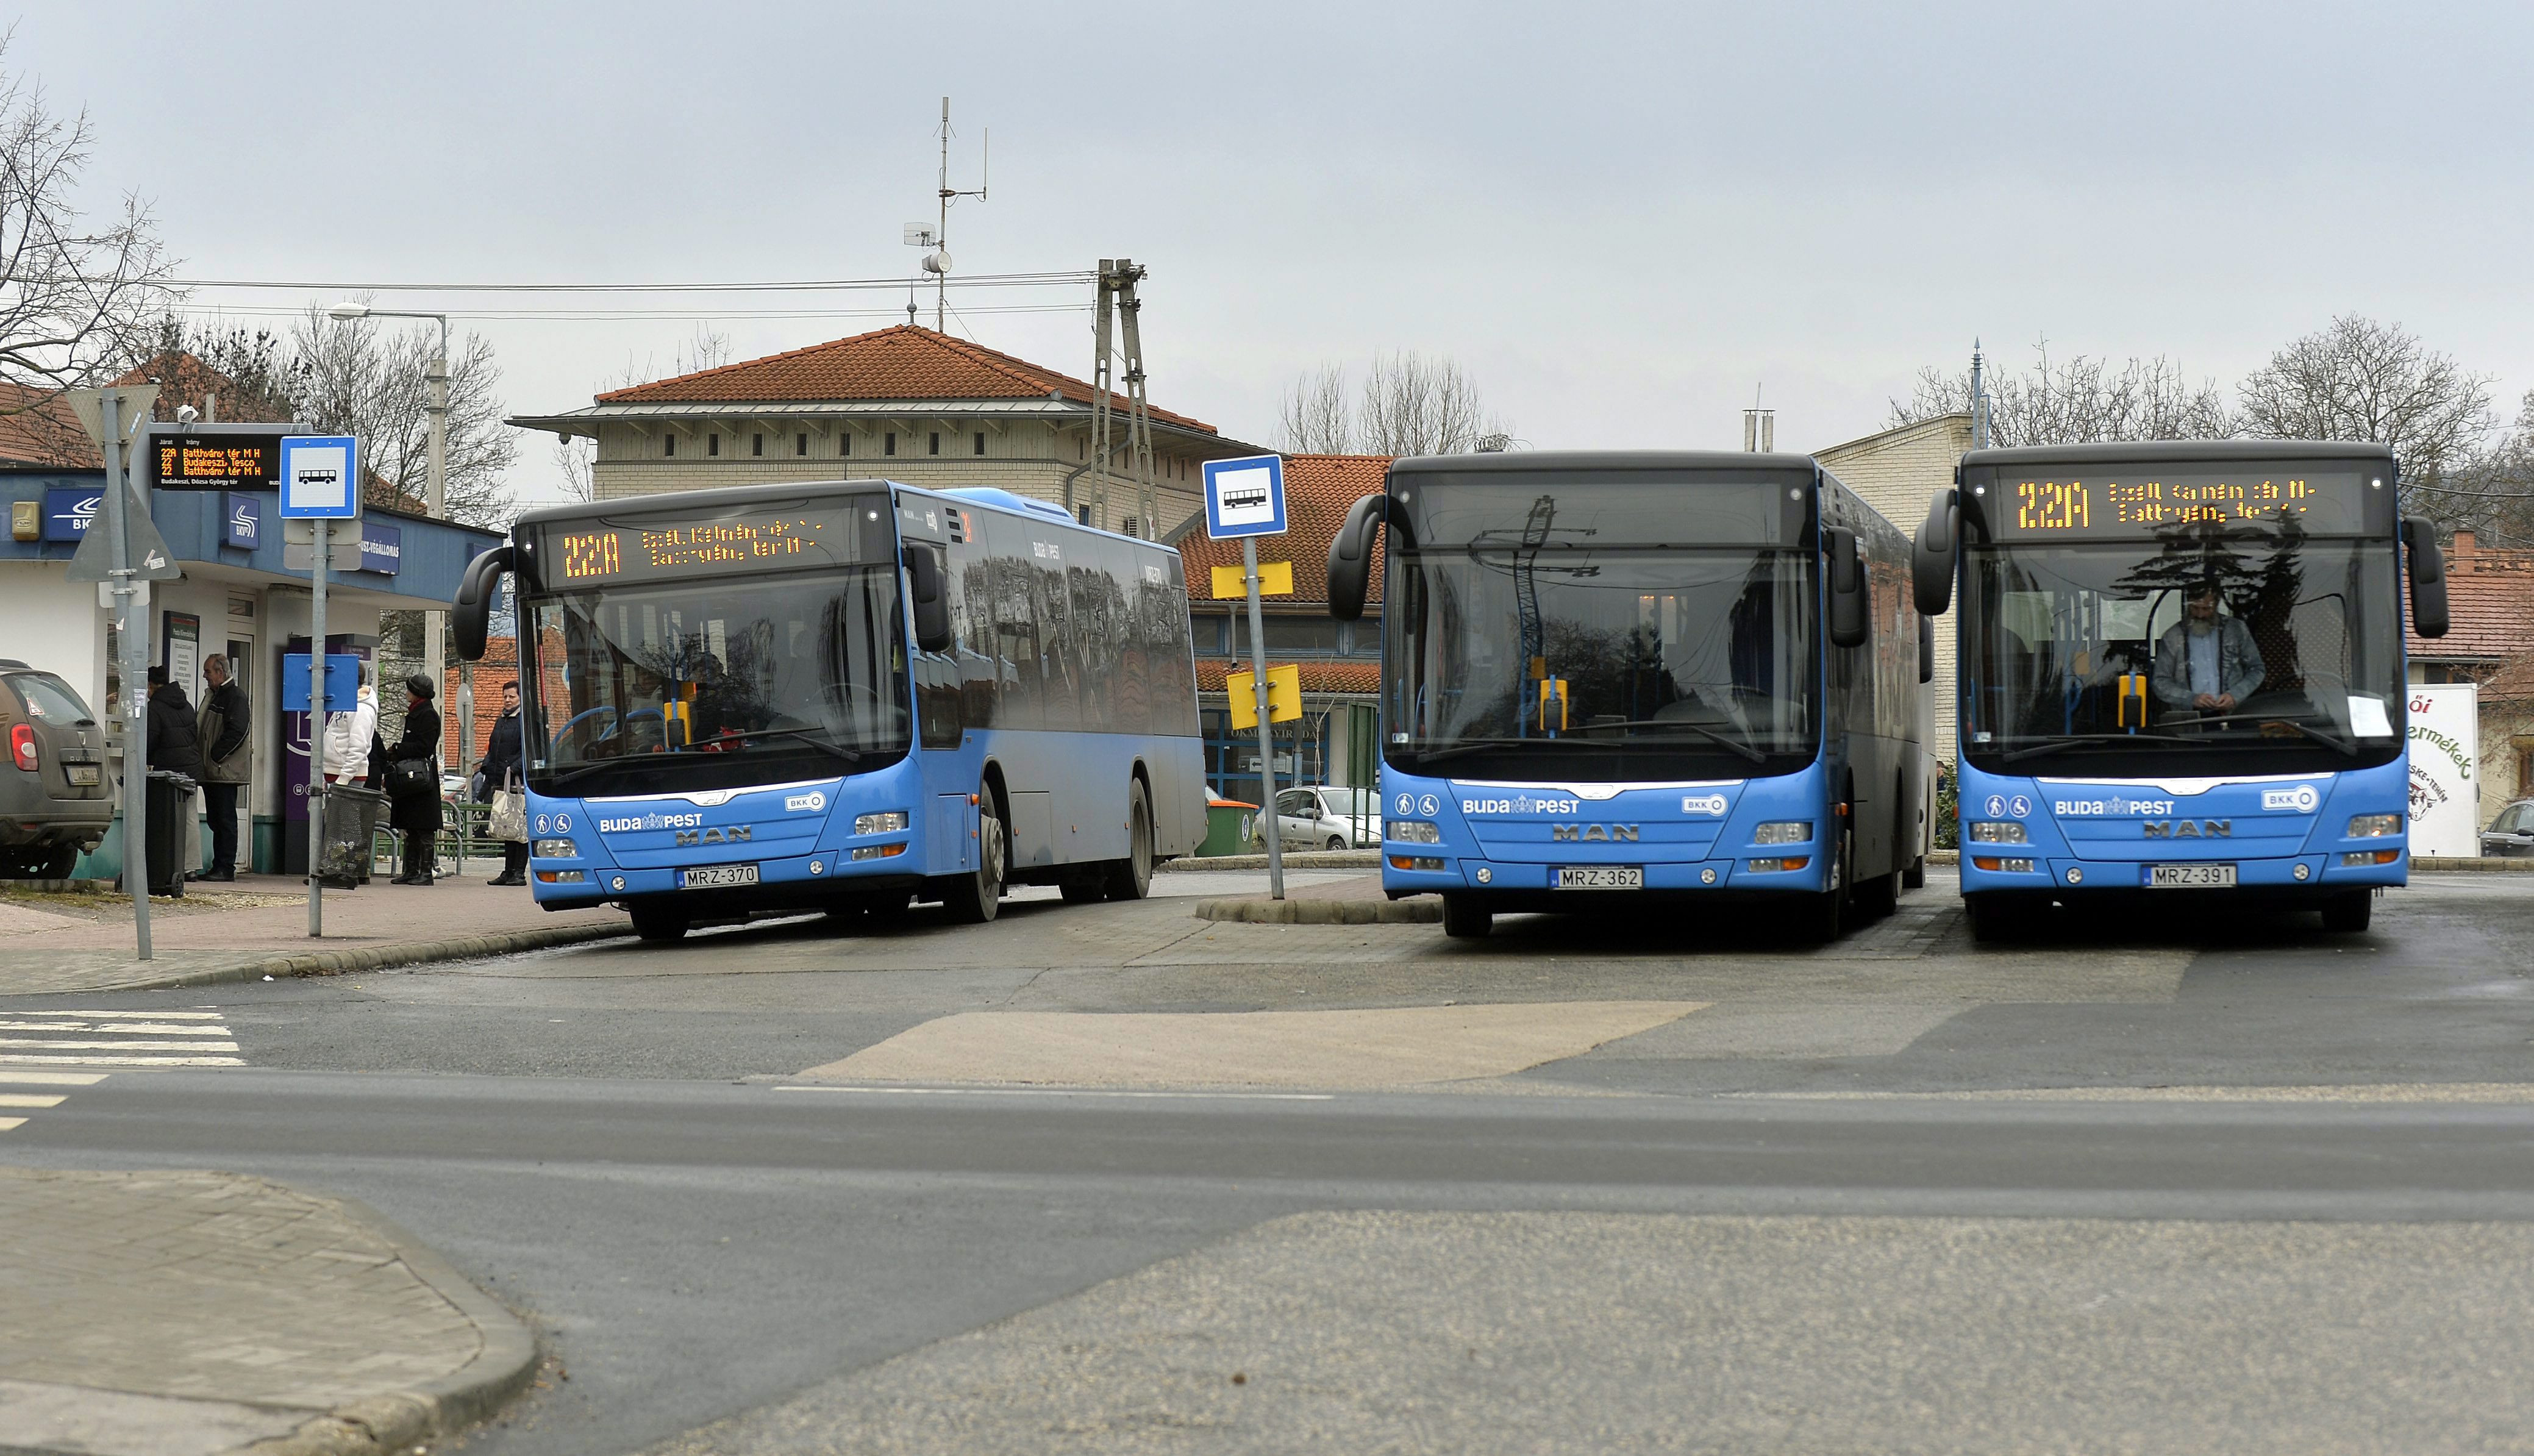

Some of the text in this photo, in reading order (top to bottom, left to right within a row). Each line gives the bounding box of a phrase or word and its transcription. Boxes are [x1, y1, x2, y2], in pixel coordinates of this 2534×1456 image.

[161, 448, 261, 458] 22A Batthyány tér M H
[161, 457, 256, 467] 22 Budakeszi, Tesco
[162, 466, 262, 476] 22 Batthyány tér M H
[2018, 481, 2090, 529] 22A
[360, 539, 399, 558] USZ-VÉGÁLLOMÁS
[563, 533, 620, 577] 22A
[2408, 694, 2433, 713] ői
[2408, 726, 2472, 779] ermékek
[676, 826, 752, 846] MAN
[1553, 824, 1639, 841] MAN
[2143, 819, 2231, 838] MAN
[687, 868, 755, 885] MRZ-370
[1563, 871, 1638, 885] MRZ-362
[2155, 868, 2230, 883] MRZ-391
